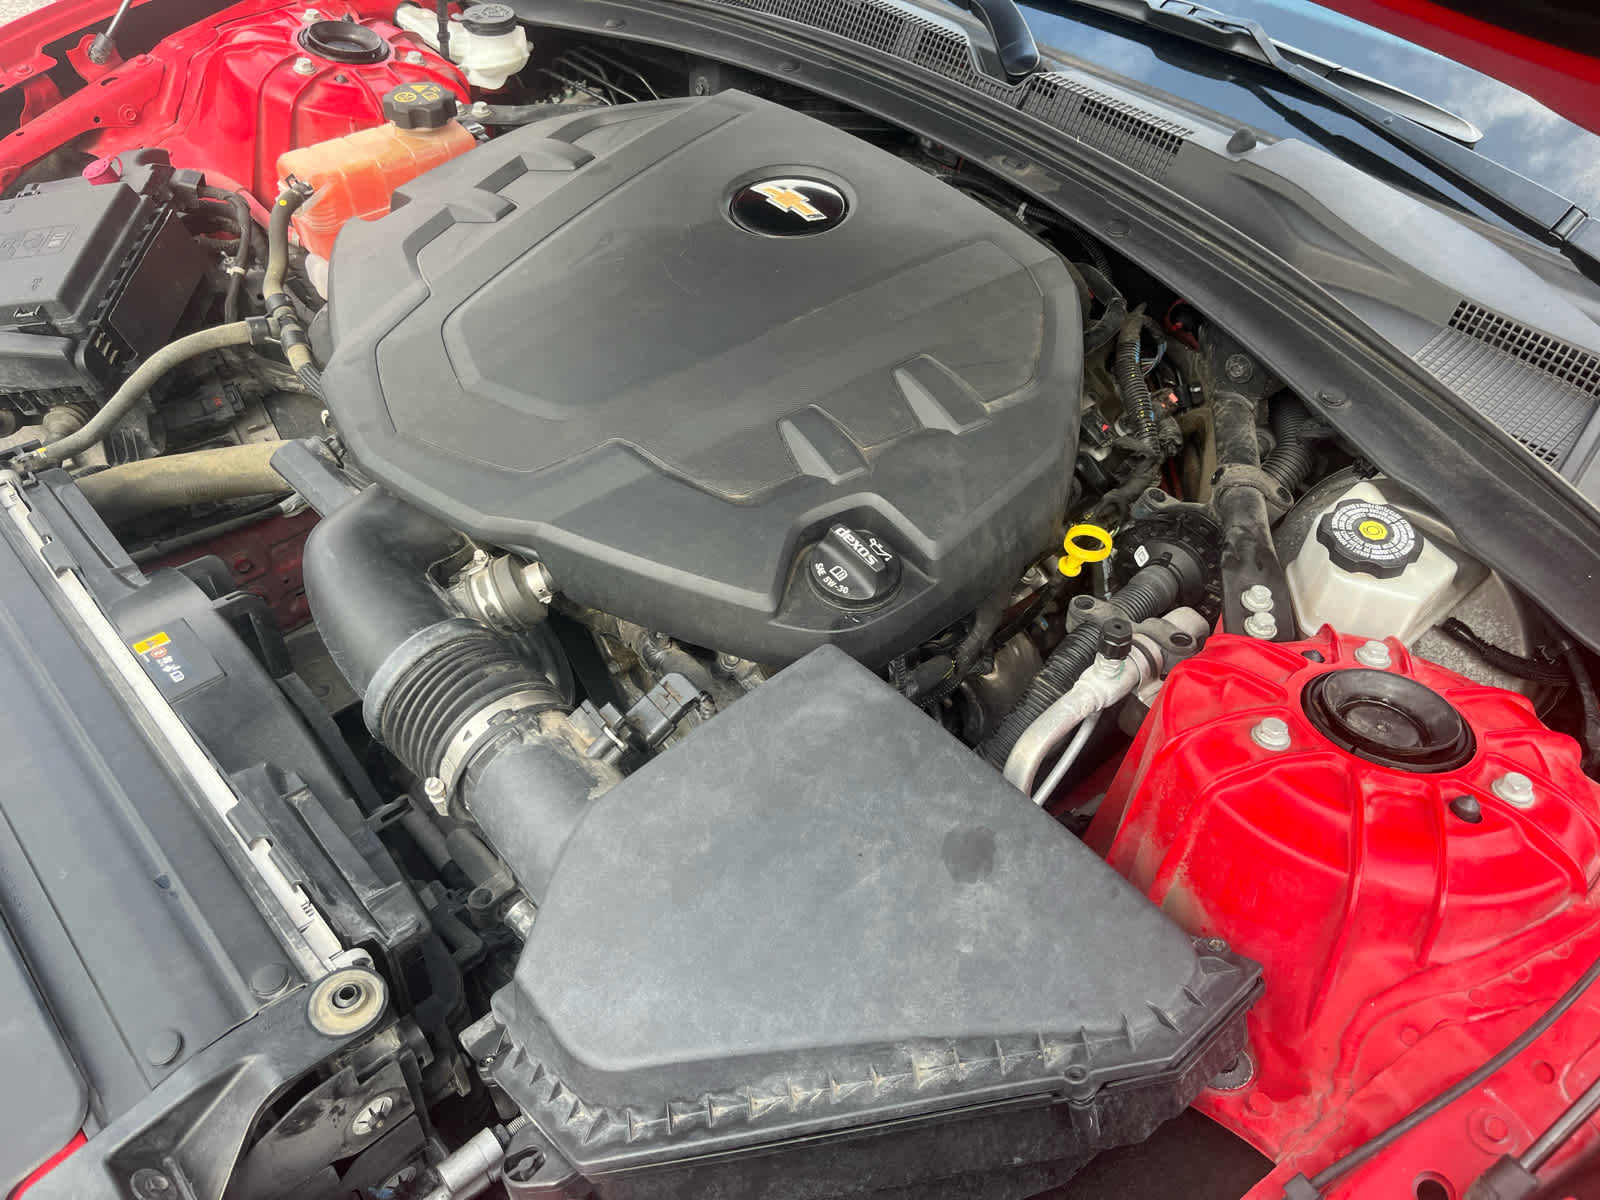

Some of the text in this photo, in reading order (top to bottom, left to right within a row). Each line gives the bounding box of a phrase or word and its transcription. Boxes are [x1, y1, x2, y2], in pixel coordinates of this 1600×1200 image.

[833, 527, 879, 566] dexos
[814, 562, 849, 595] SAE 5W-30
